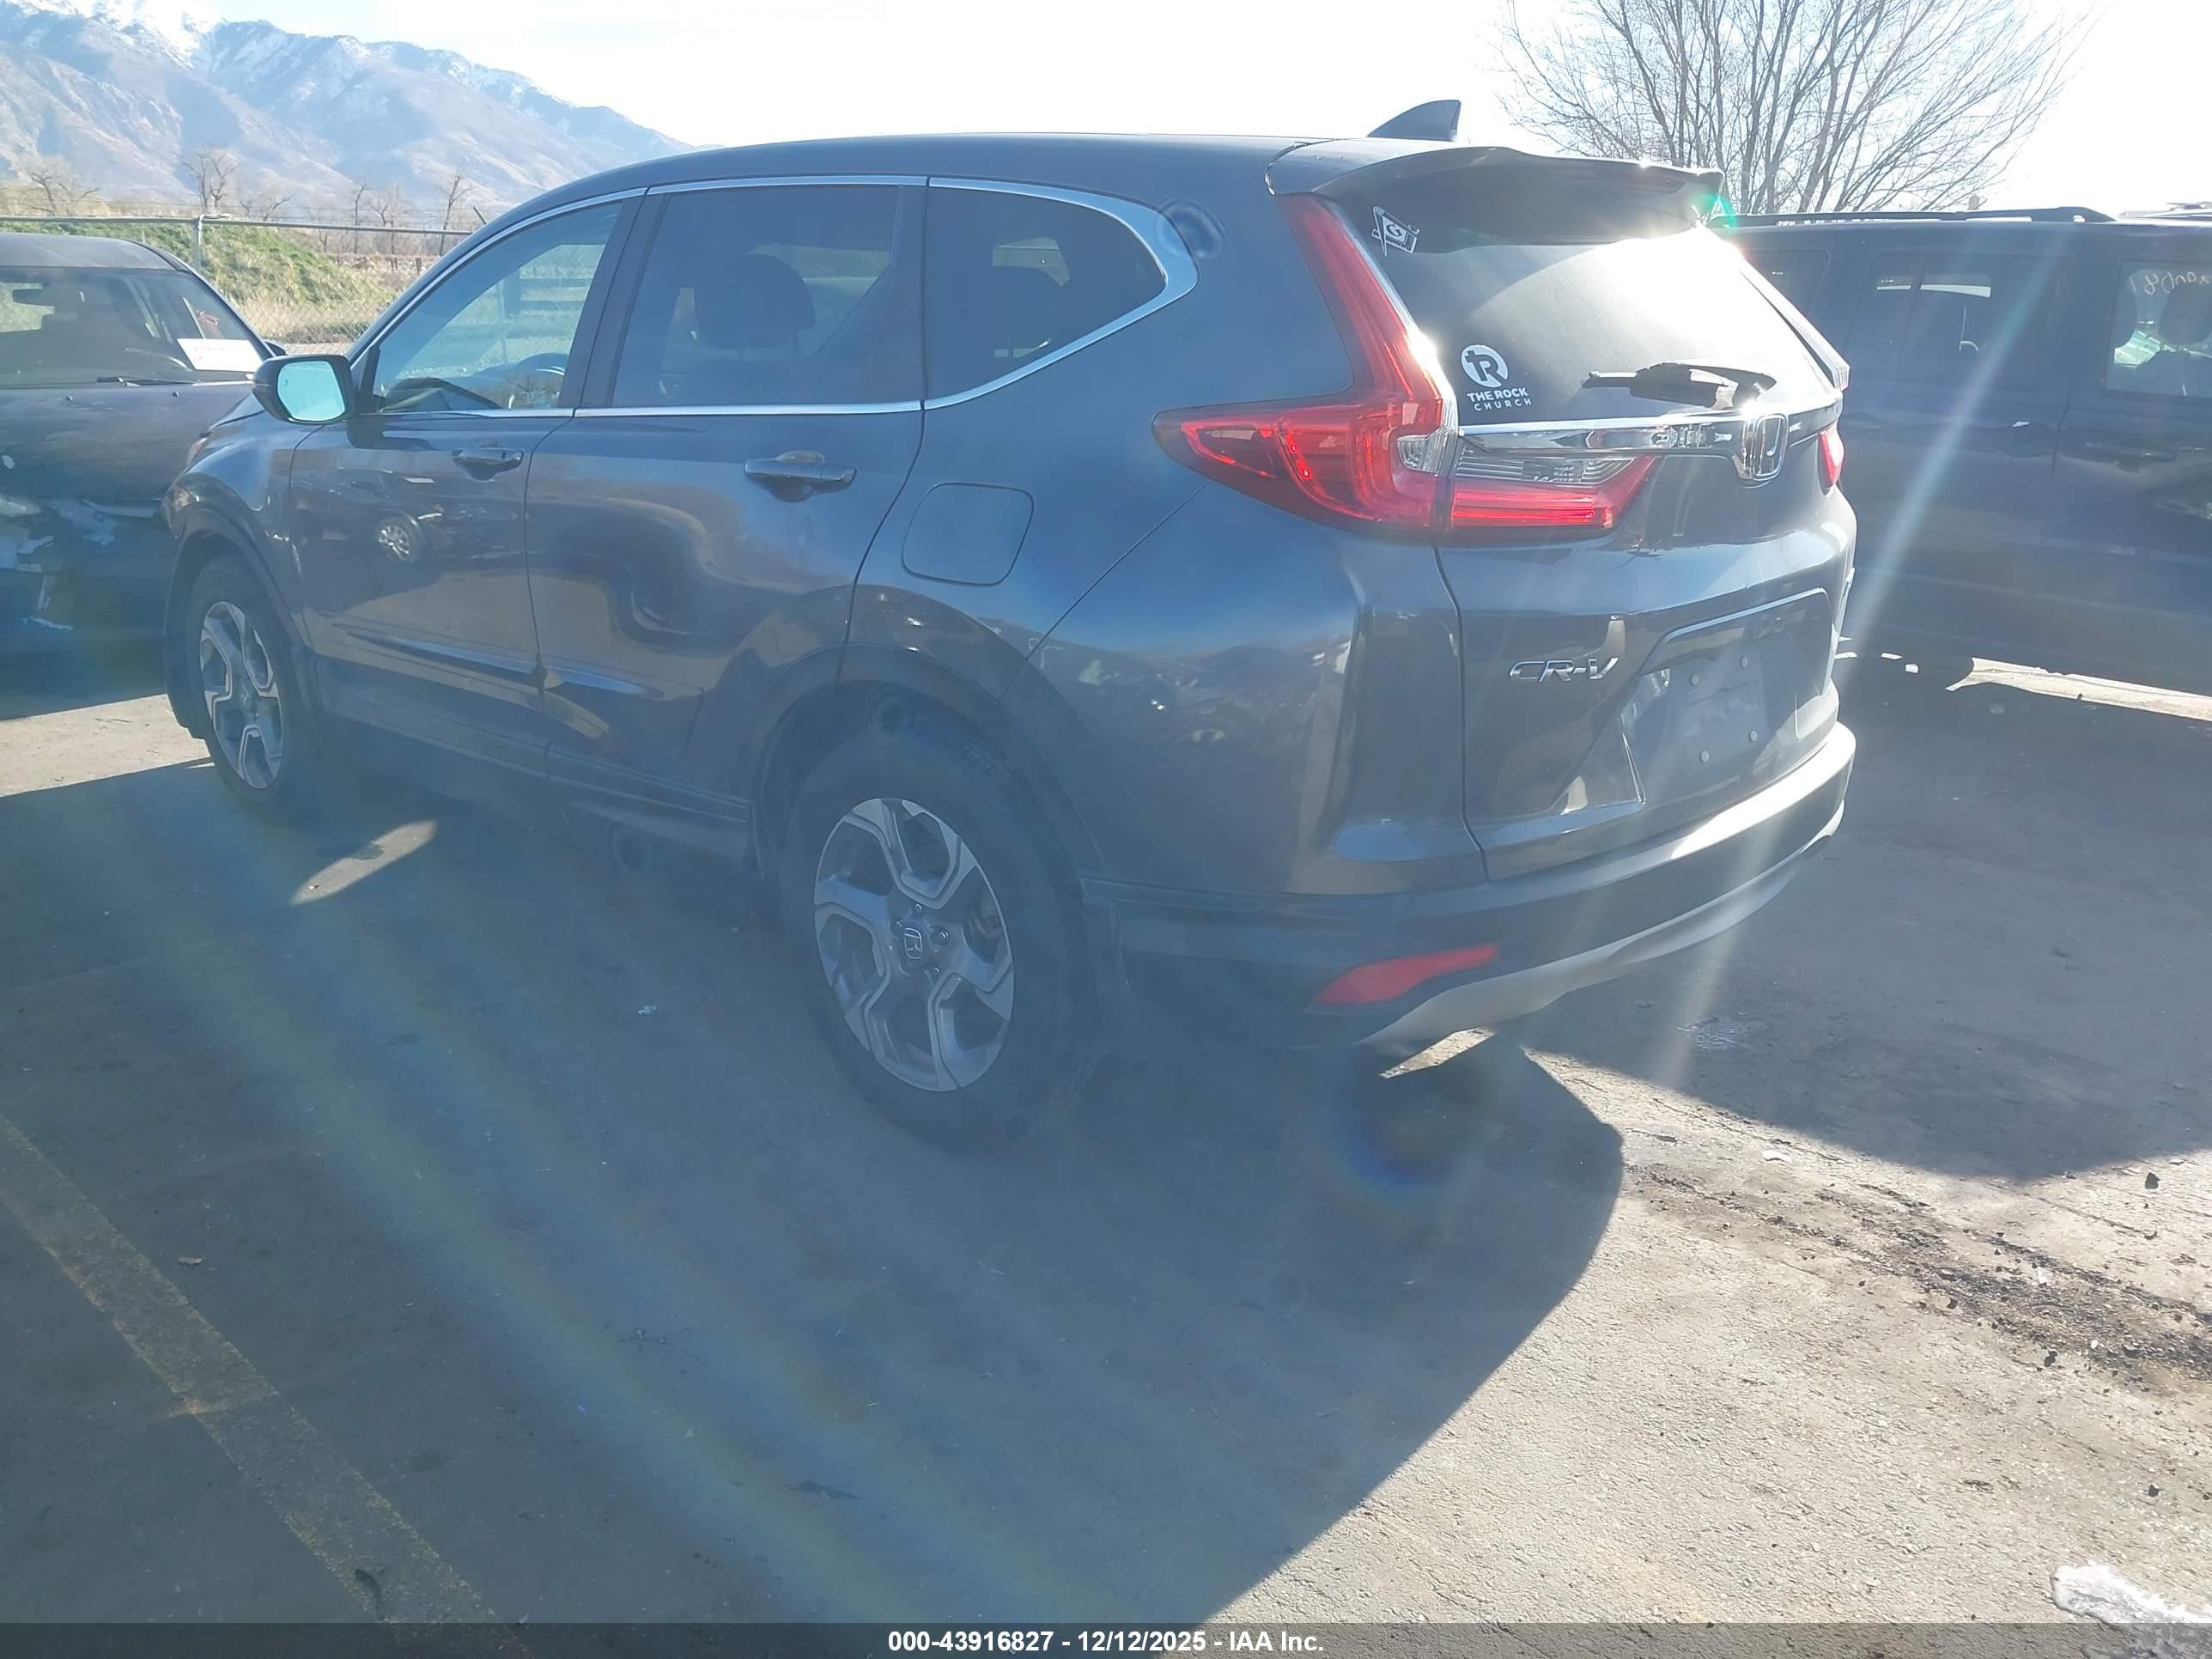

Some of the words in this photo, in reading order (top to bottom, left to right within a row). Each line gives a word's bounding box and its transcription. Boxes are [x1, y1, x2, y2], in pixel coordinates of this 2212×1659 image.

[1467, 391, 1495, 403] THE
[1494, 387, 1528, 399] ROCK
[1474, 398, 1532, 411] CHURCH
[1510, 657, 1619, 683] CR-V
